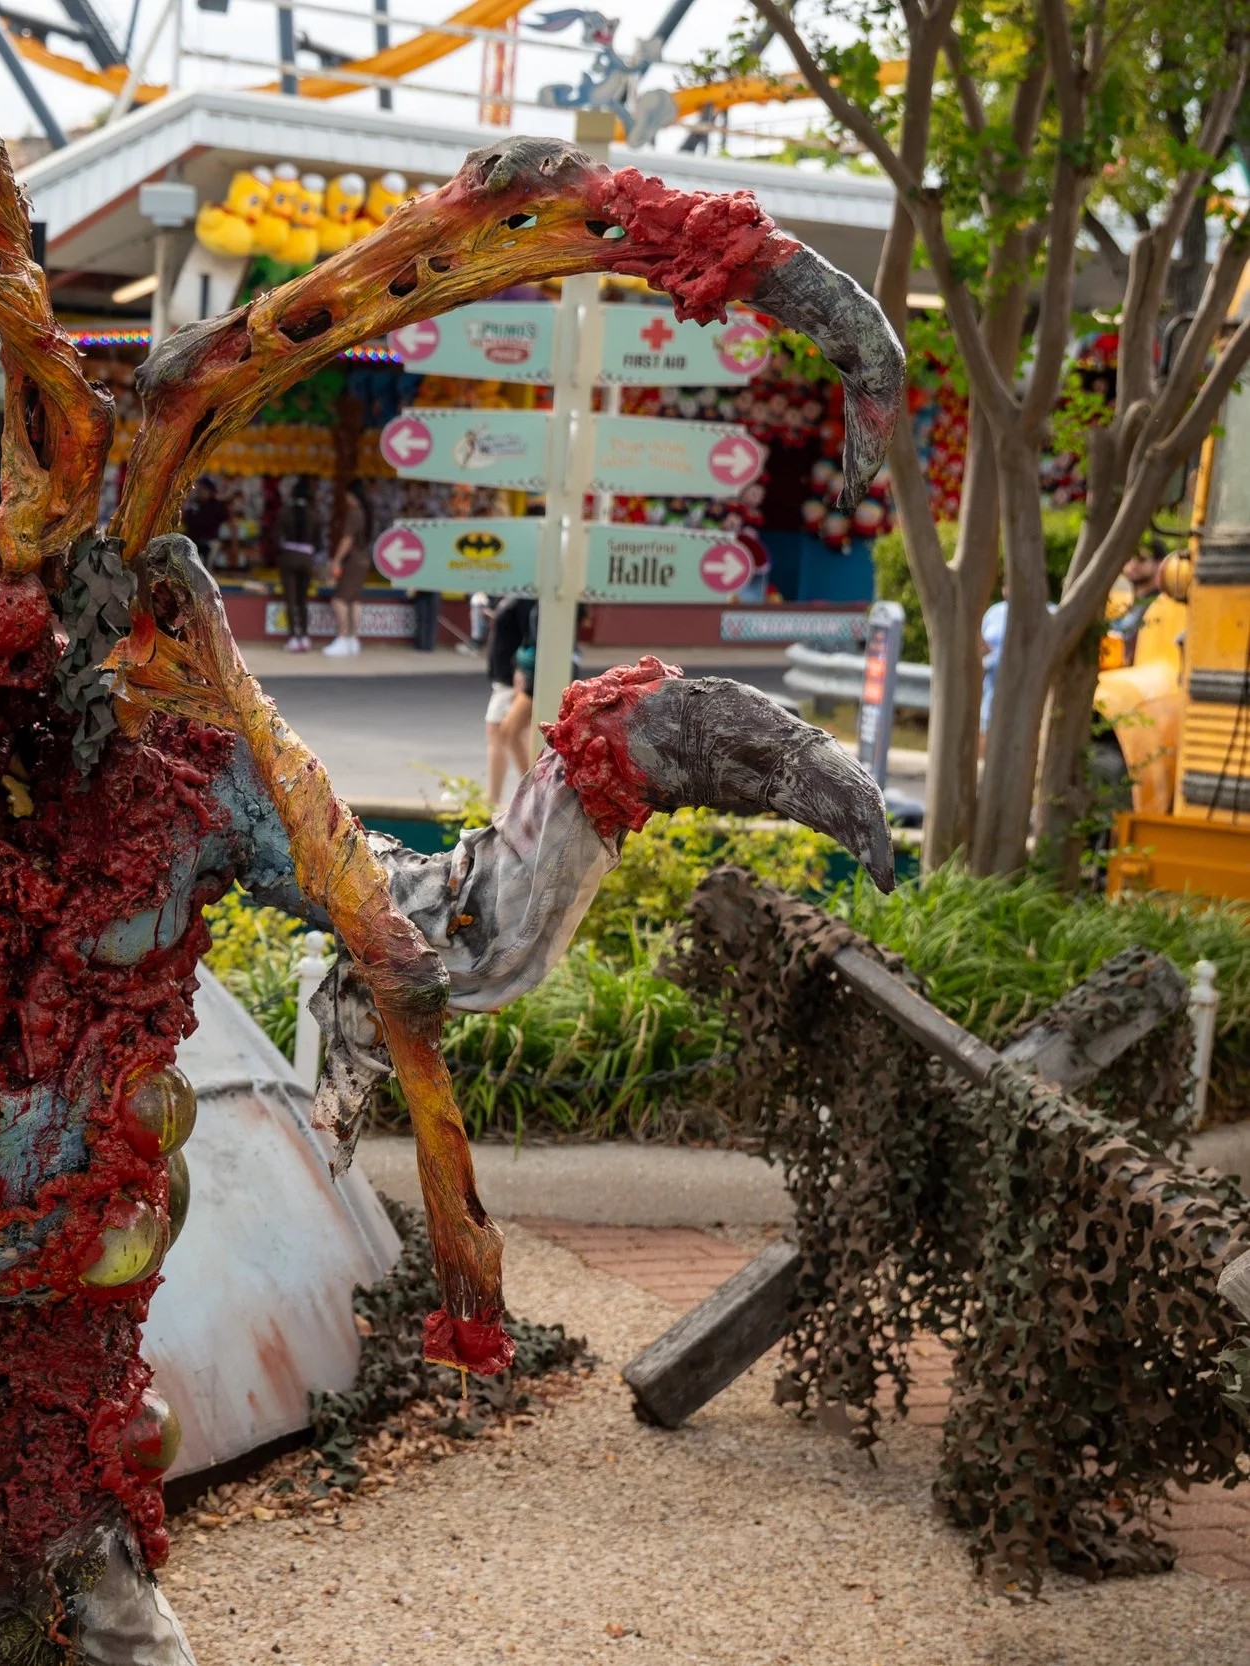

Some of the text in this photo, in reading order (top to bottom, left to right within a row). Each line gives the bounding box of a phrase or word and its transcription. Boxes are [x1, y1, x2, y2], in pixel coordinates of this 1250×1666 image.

[623, 354, 687, 370] FIRST AID
[607, 556, 675, 587] Halle
